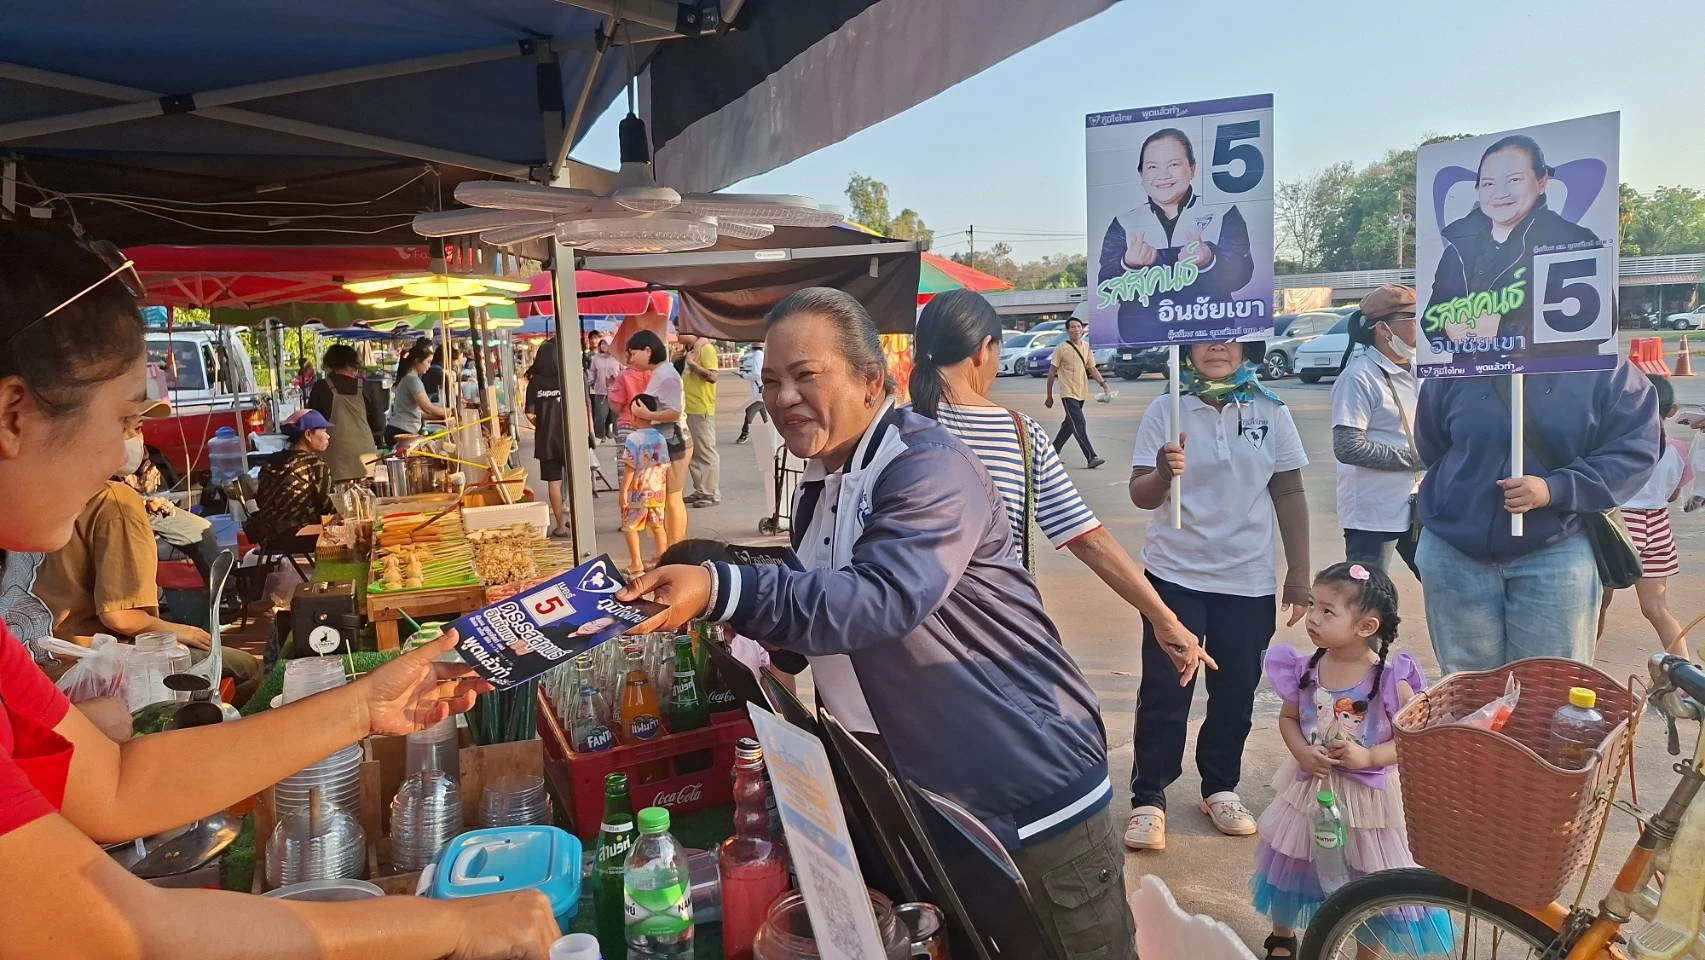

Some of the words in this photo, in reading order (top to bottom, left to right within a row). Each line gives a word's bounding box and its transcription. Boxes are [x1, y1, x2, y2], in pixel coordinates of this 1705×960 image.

[1142, 105, 1179, 120] พูดแล้วทำ
[1211, 119, 1265, 194] 5
[1096, 241, 1201, 308] รสสุคนธ์
[1158, 296, 1265, 322] อินชัยเขา
[1424, 267, 1527, 333] รสสุคนธ์
[1542, 257, 1601, 333] 5
[1430, 332, 1526, 354] อินชัยเขา
[1475, 361, 1515, 373] พูดแล้วทำ
[534, 595, 565, 615] 5
[461, 635, 513, 679] พูดแล้วทำ
